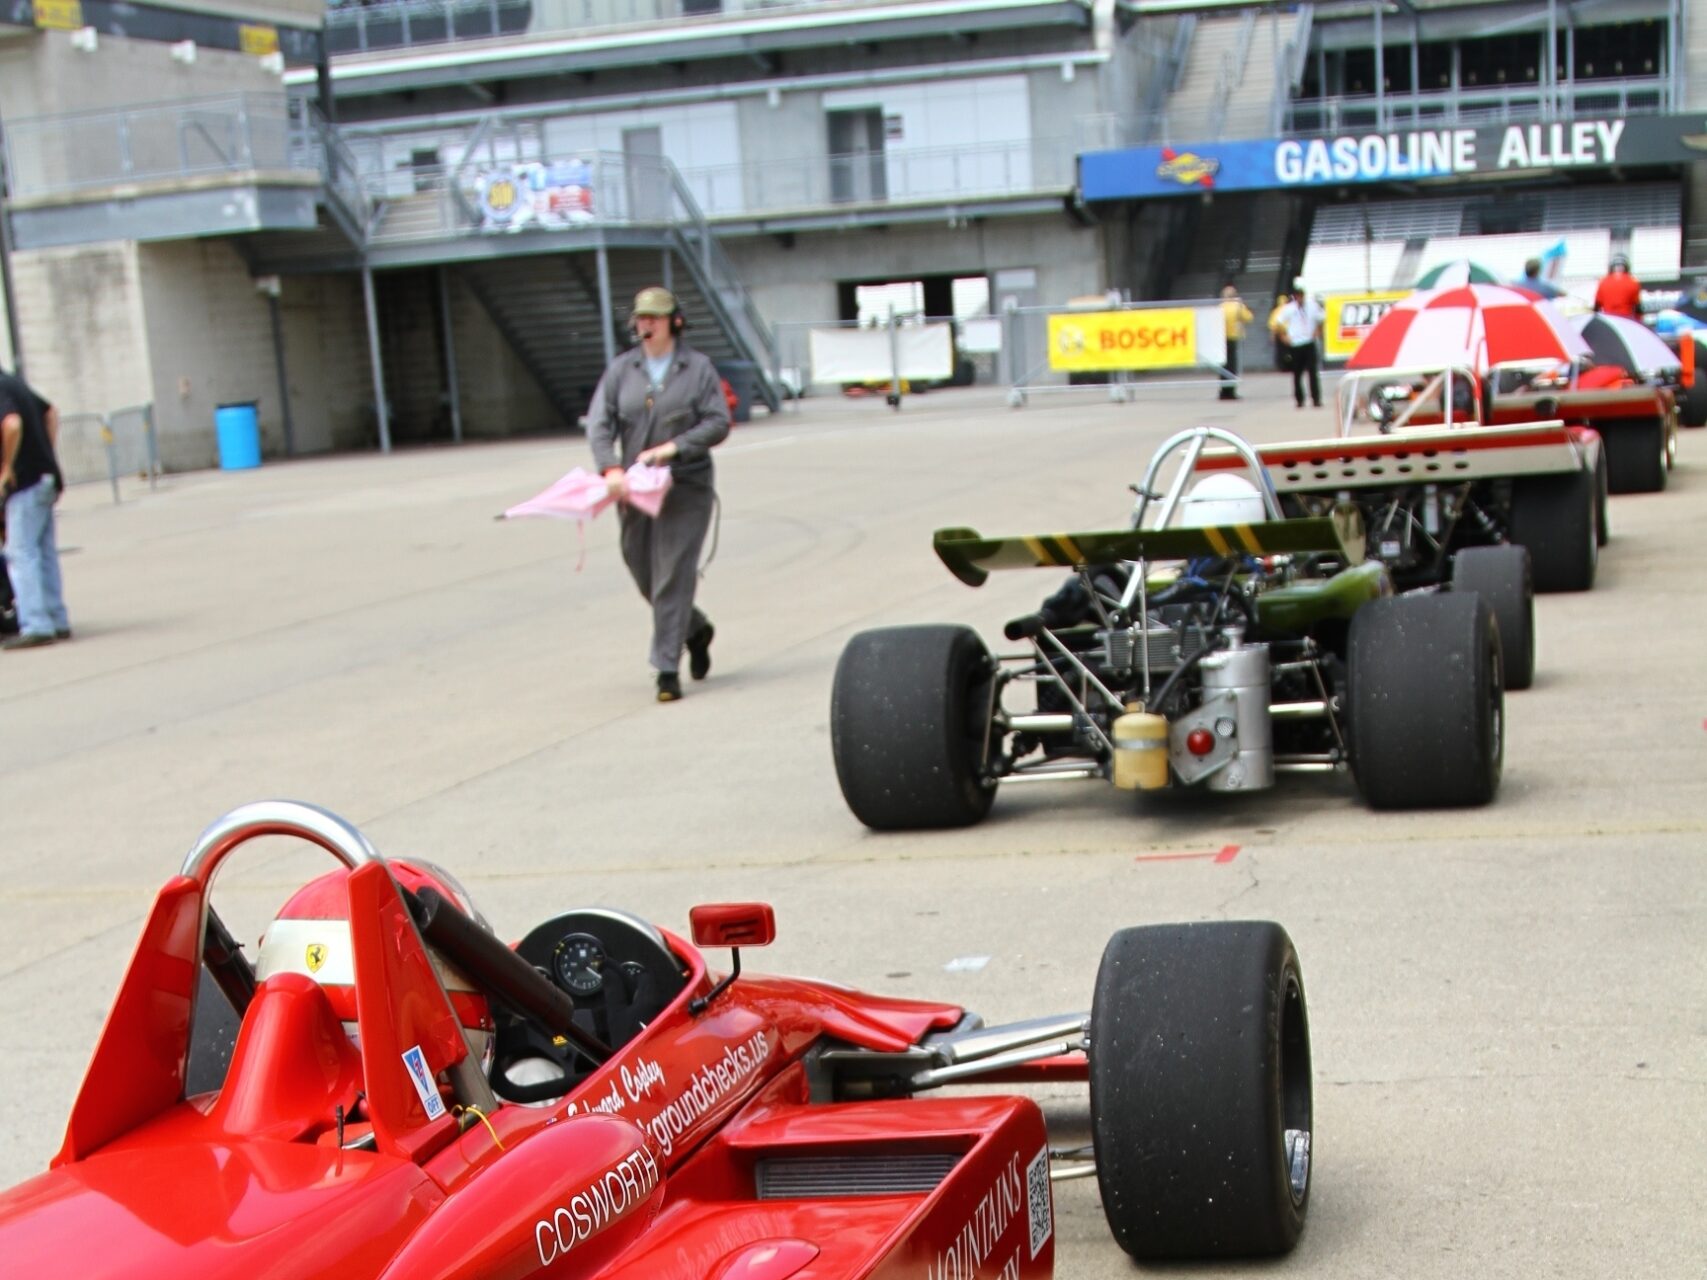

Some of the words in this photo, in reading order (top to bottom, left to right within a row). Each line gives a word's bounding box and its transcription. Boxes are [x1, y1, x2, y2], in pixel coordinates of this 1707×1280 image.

[1274, 128, 1478, 185] GASOLINE
[1497, 119, 1626, 169] ALLEY
[1099, 327, 1189, 352] BOSCH
[1341, 301, 1395, 325] OPT
[567, 1079, 626, 1117] ard
[619, 1056, 666, 1103] Copley
[535, 1143, 660, 1267] COSWORTH
